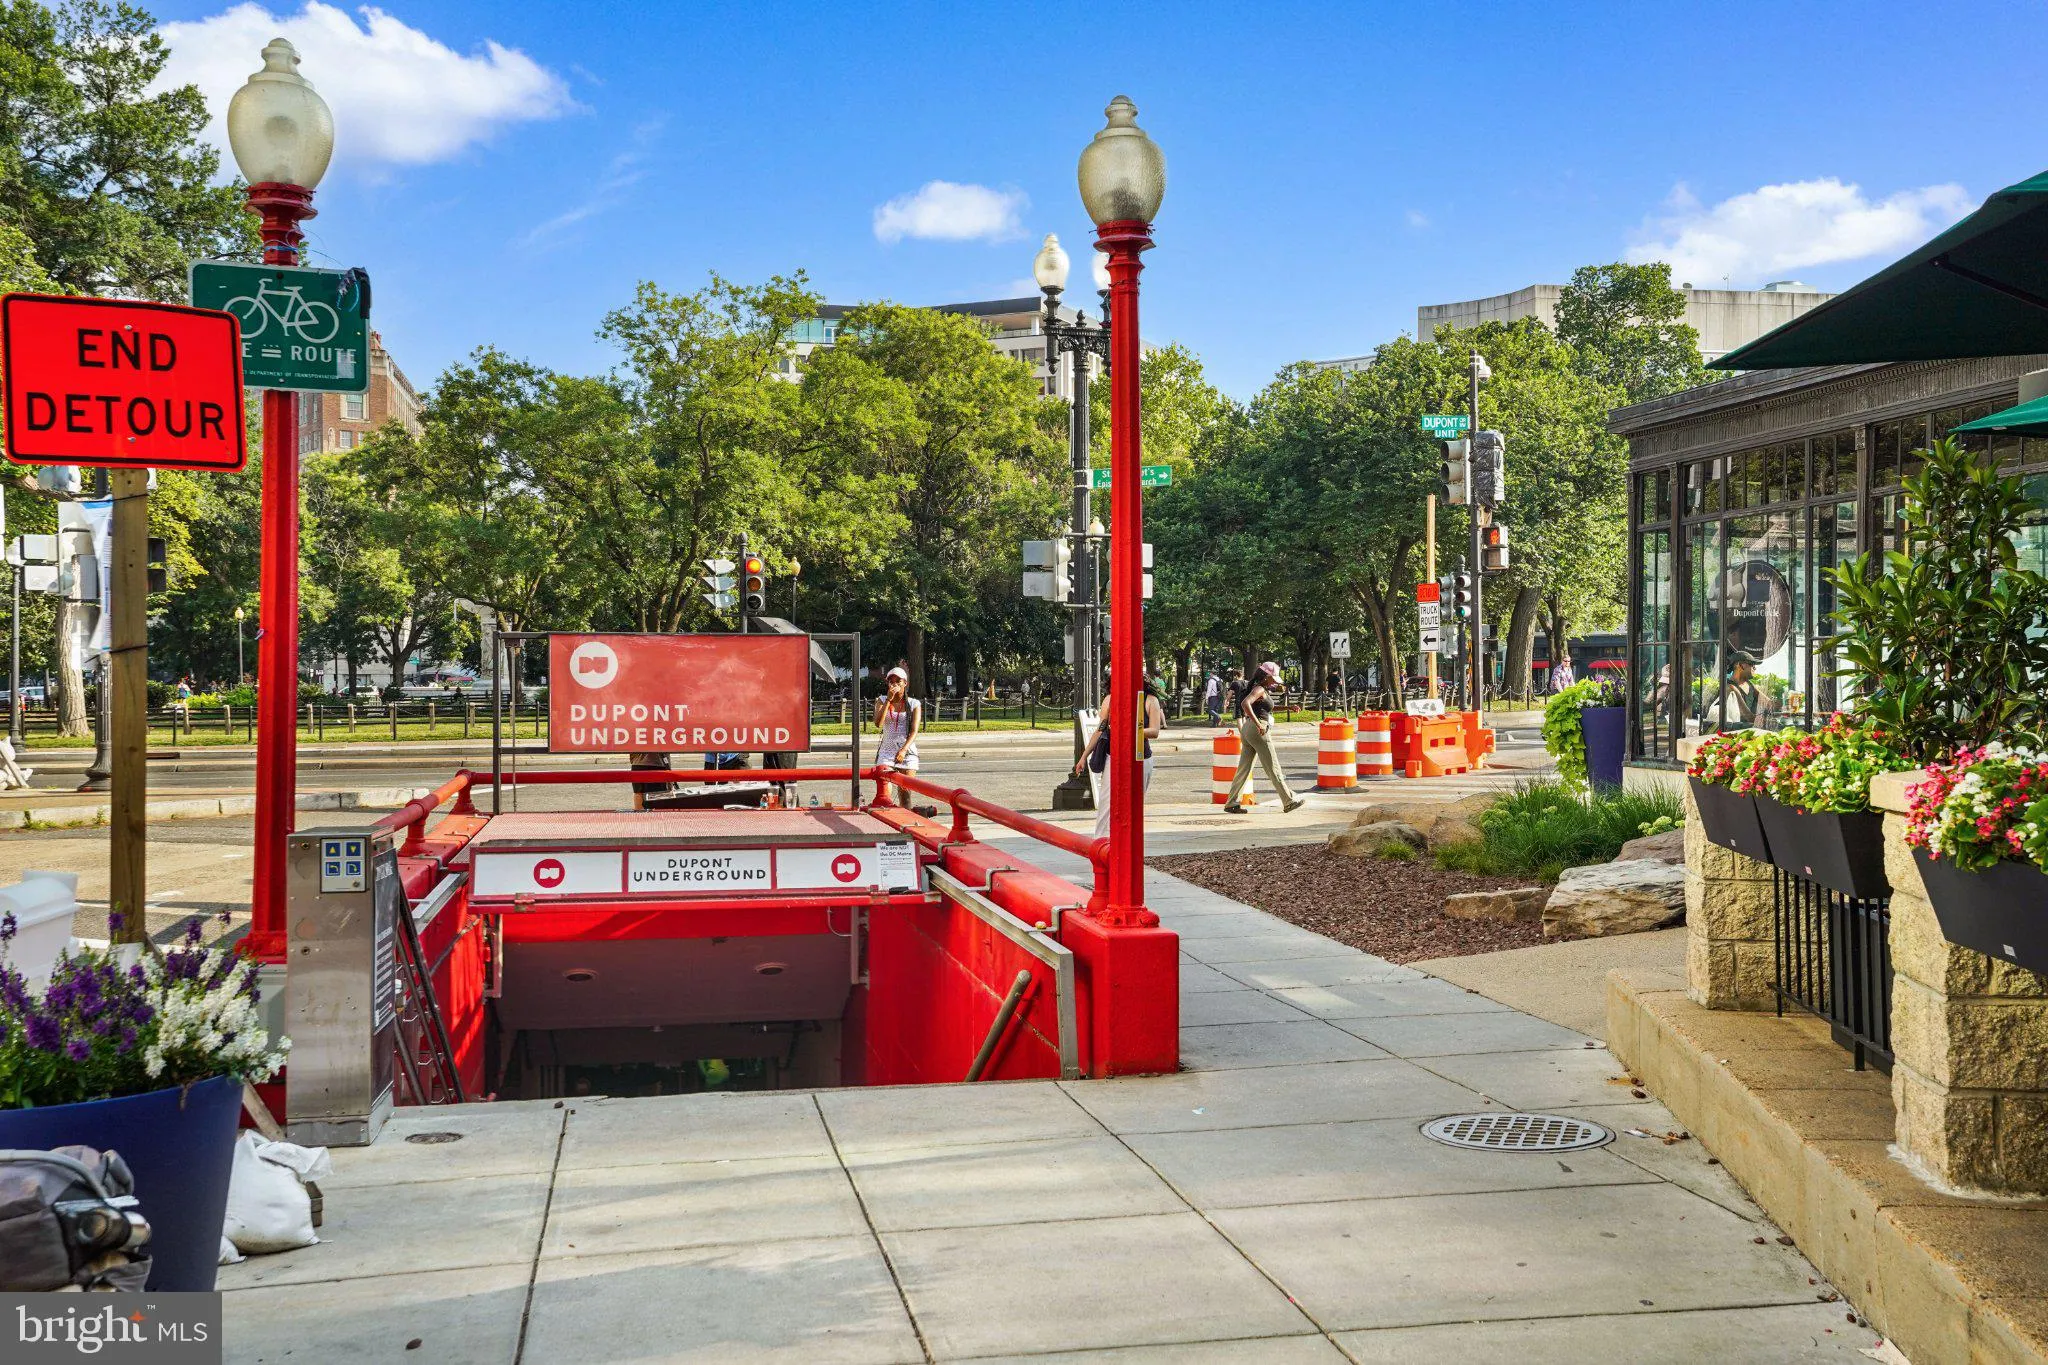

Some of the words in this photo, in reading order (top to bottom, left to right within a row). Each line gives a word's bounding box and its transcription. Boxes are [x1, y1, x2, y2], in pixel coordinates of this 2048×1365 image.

[77, 328, 178, 372] END
[290, 345, 357, 364] ROUTE
[26, 391, 226, 441] DETOUR
[1424, 417, 1458, 428] DUPONT
[1435, 429, 1456, 438] UNIT
[1420, 605, 1438, 615] TRUCK
[1733, 609, 1759, 618] Dupont
[1420, 616, 1438, 626] ROUTE
[570, 704, 688, 722] DUPONT
[570, 727, 790, 745] UNDERGROUND
[667, 857, 733, 869] DUPONT
[633, 869, 767, 882] UNDERGROUND
